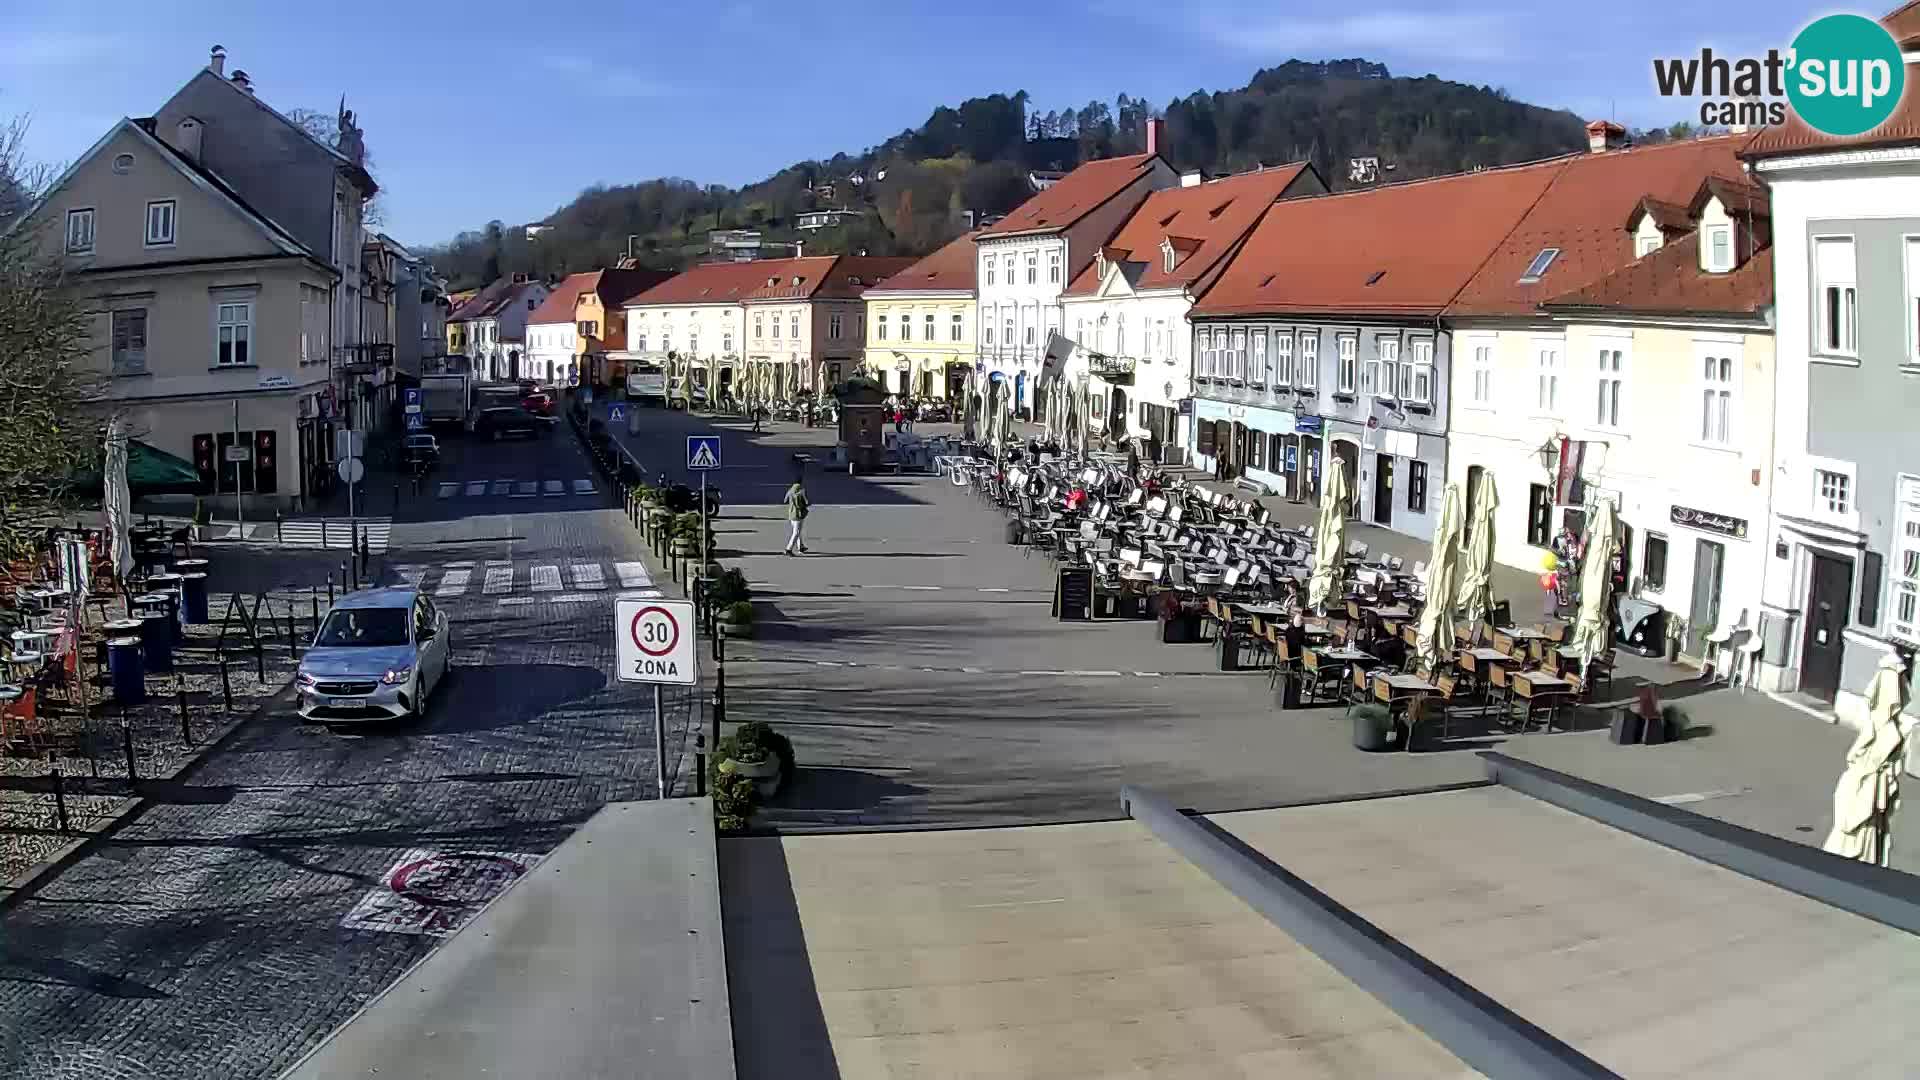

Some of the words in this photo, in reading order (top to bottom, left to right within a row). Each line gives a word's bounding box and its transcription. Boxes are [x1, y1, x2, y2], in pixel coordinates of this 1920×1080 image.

[408, 391, 417, 402] P
[643, 622, 668, 643] 30
[634, 659, 678, 677] ZONA
